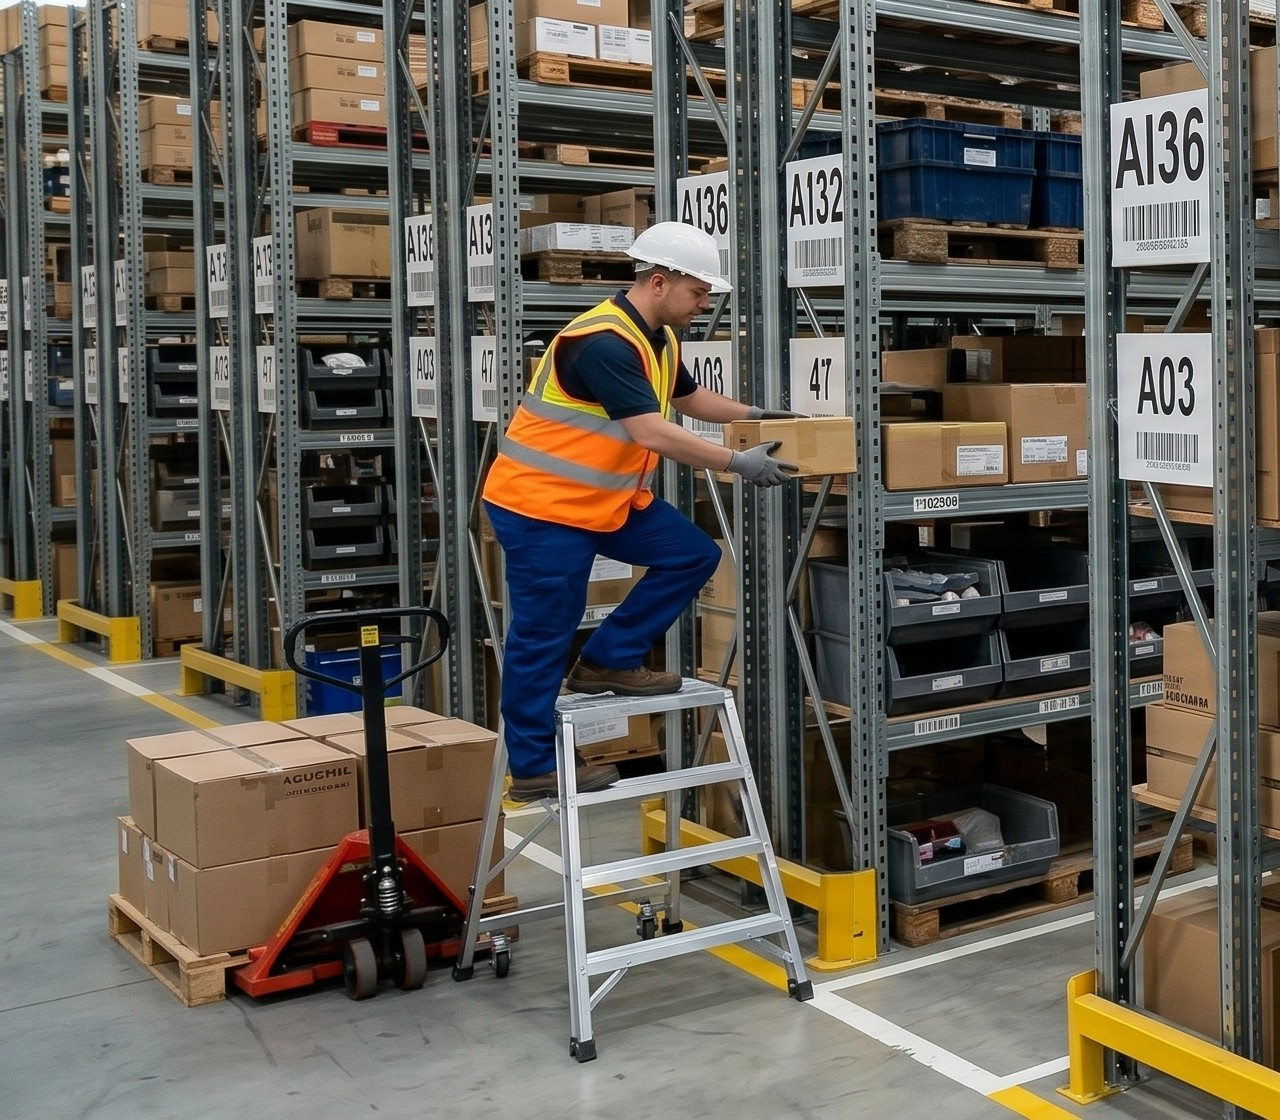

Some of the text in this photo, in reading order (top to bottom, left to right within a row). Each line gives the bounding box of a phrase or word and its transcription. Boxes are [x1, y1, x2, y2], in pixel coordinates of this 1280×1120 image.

[681, 183, 729, 235] A136
[789, 167, 843, 228] A132
[809, 357, 832, 401] 47
[1136, 356, 1195, 417] A03
